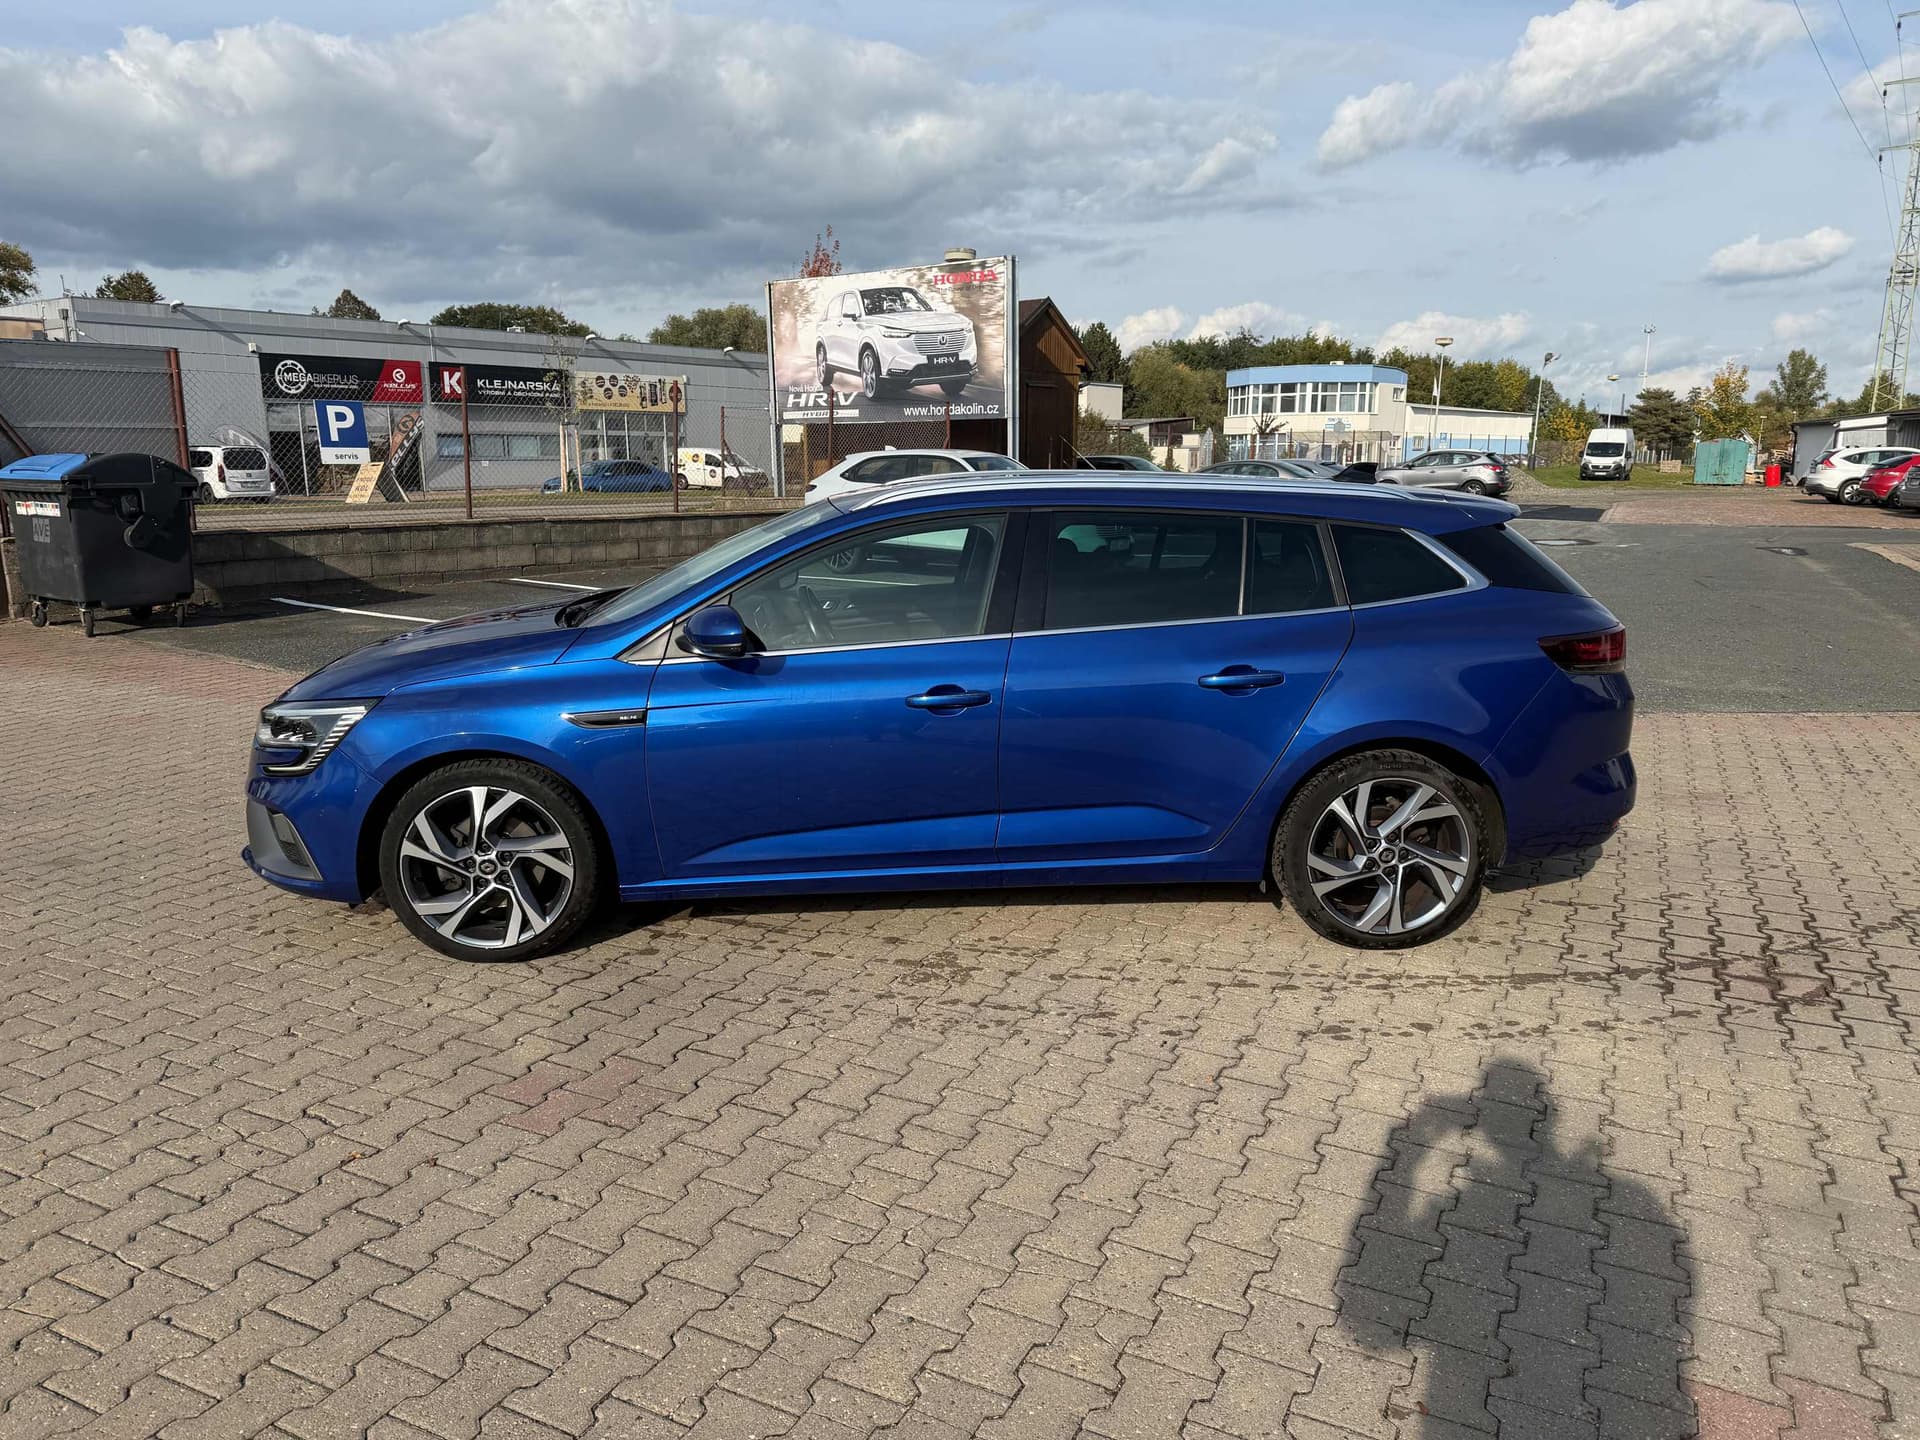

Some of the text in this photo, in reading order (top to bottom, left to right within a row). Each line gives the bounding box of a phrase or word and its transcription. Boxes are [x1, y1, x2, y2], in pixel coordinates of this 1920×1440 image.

[933, 269, 998, 285] HONDA
[933, 356, 956, 365] HR-V
[443, 371, 462, 394] K
[787, 391, 858, 407] HR-V
[326, 405, 355, 442] P
